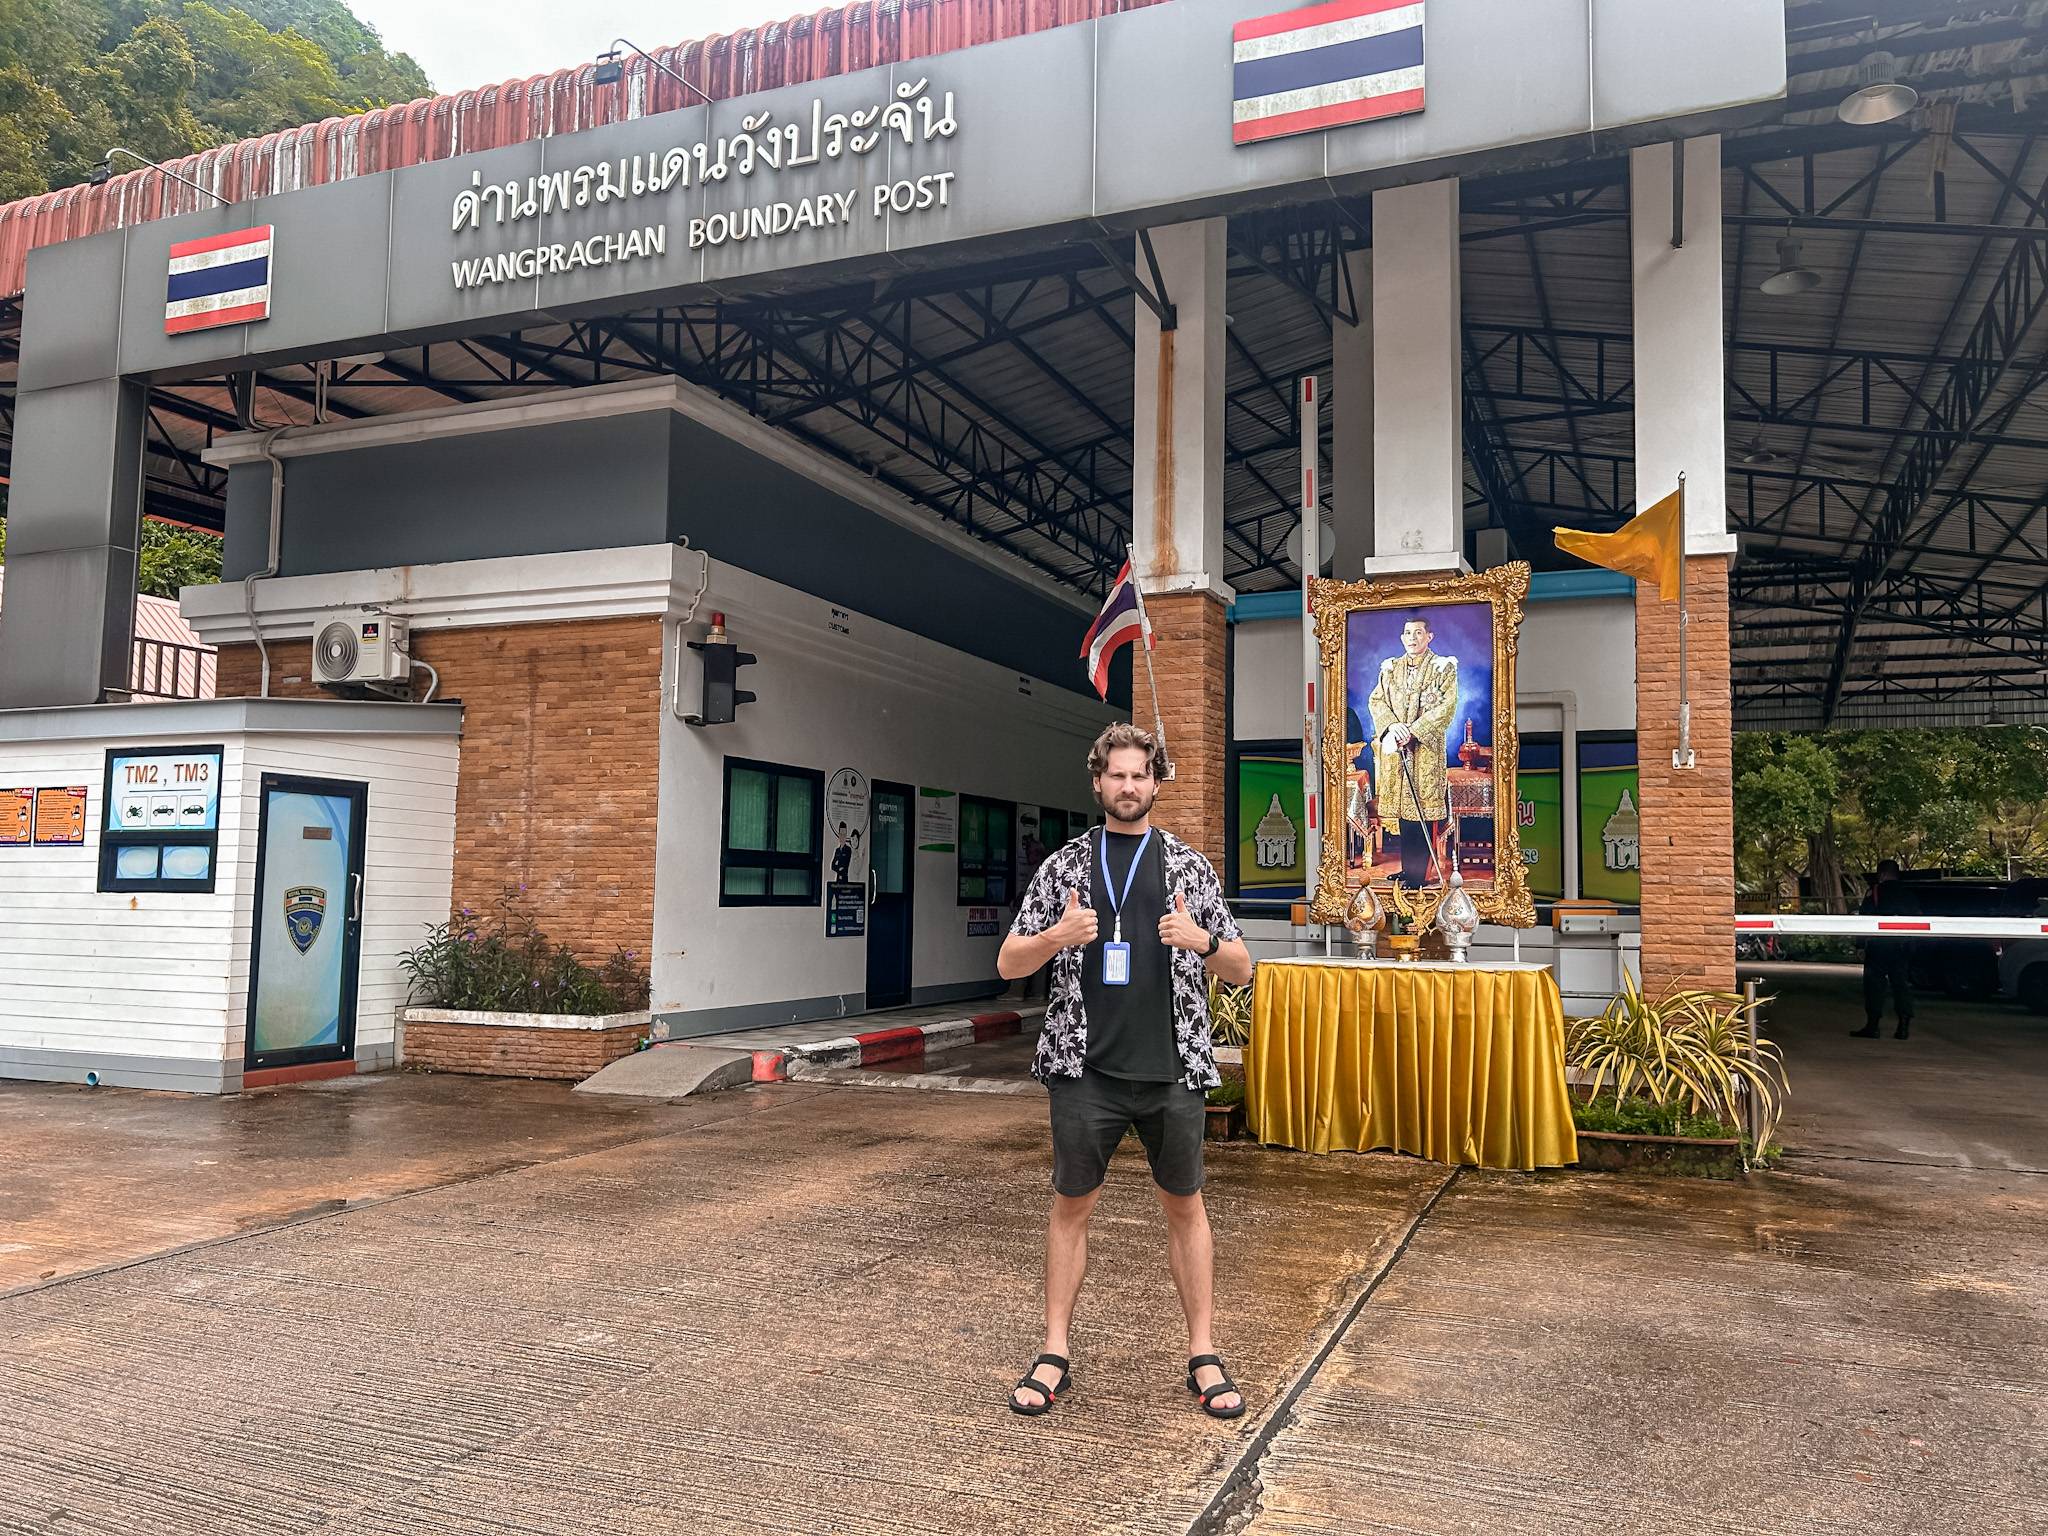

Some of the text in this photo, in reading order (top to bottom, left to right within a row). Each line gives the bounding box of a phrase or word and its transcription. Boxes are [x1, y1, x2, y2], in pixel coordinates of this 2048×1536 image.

[452, 77, 957, 231] ด่านพรมแดนวังประจัน
[452, 171, 955, 288] WANGPRACHAN BOUNDARY POST
[125, 764, 158, 784] TM2
[174, 763, 208, 782] TM3
